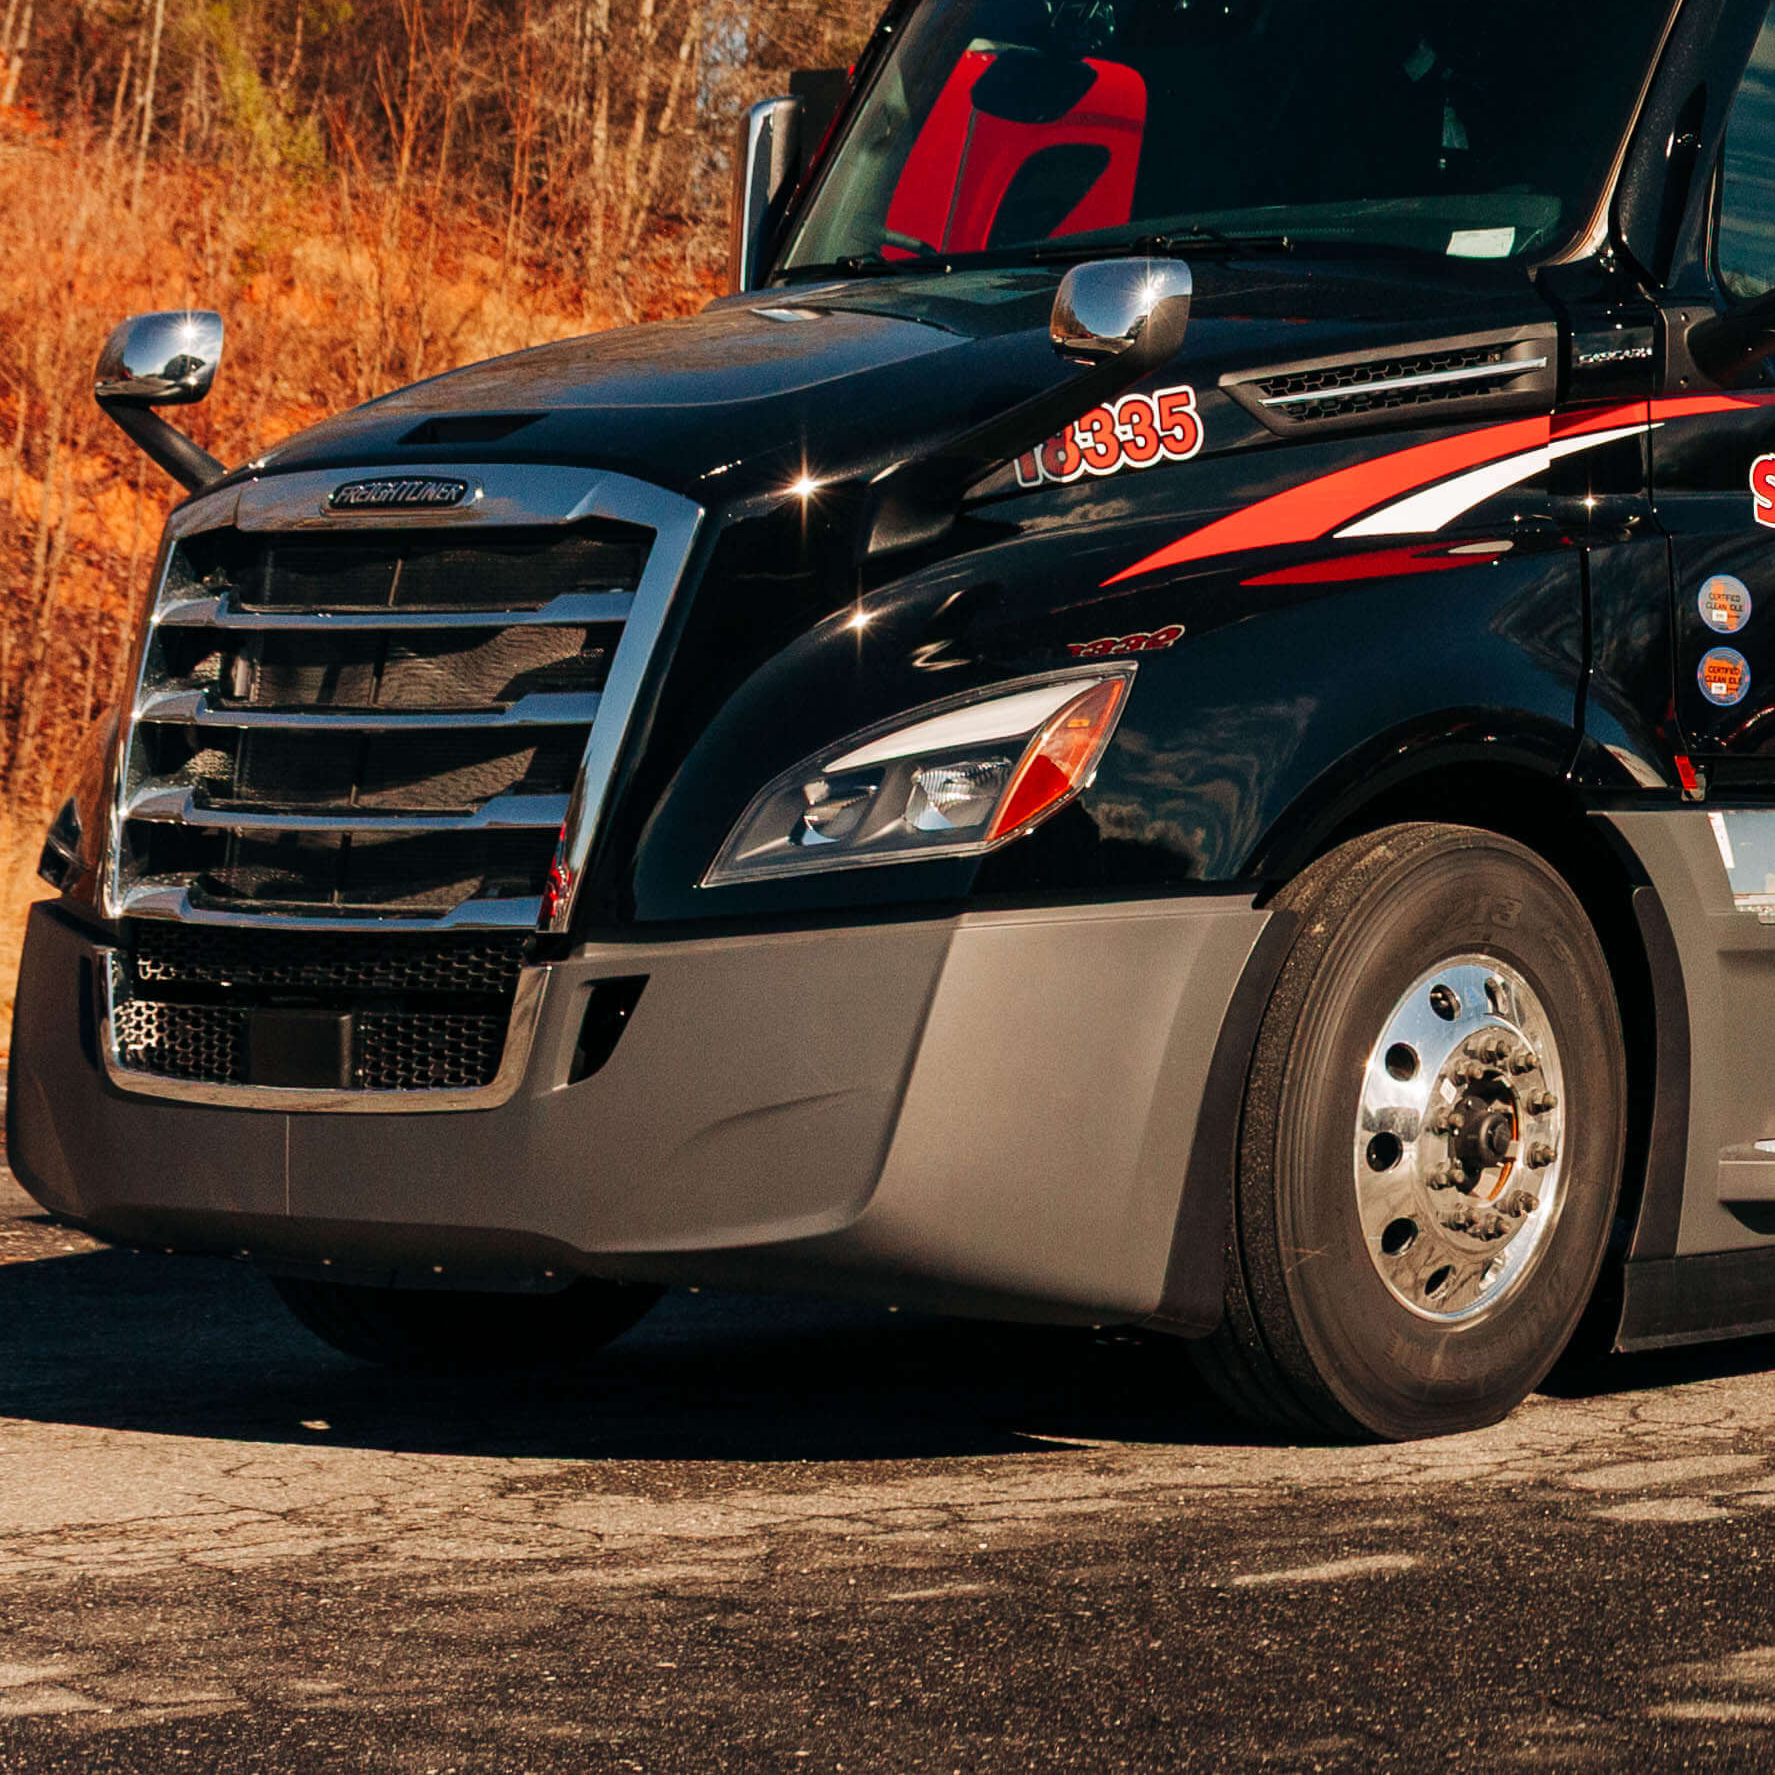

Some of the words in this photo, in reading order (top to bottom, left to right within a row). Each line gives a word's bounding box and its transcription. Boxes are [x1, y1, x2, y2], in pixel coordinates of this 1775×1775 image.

[334, 480, 460, 505] FREIGHTLINER
[1708, 592, 1741, 603] CERTIFIED
[1705, 601, 1728, 611] CLEAN
[1730, 604, 1744, 613] IDLE
[1708, 665, 1741, 676] CERTIFIED
[1704, 674, 1727, 684] CLEAN
[1728, 676, 1743, 686] IDLE
